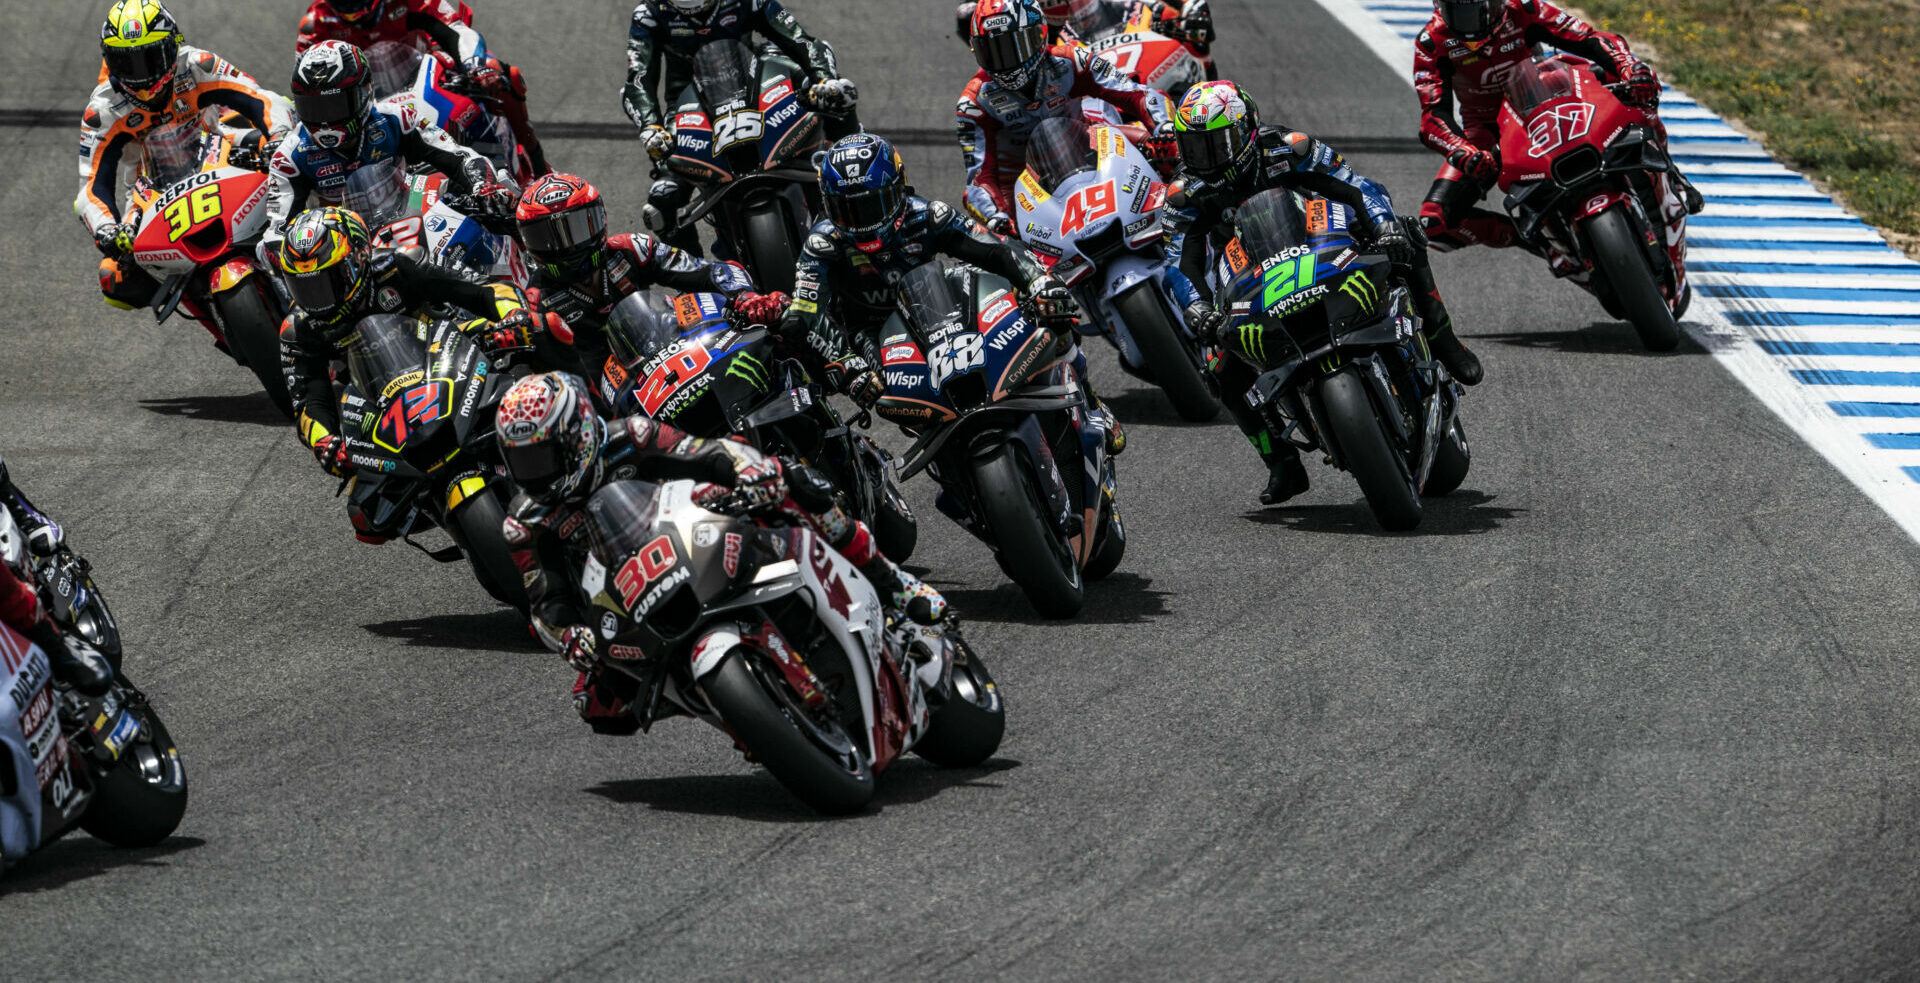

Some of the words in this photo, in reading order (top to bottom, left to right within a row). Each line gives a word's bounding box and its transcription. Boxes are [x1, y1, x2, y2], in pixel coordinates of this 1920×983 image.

[986, 17, 1008, 27] SHOEI
[1091, 32, 1141, 52] EPSOL
[1501, 42, 1514, 53] elf
[716, 101, 746, 115] aprilia
[766, 99, 800, 128] Wispr
[677, 135, 709, 150] Wispr
[712, 109, 765, 157] 25
[1528, 102, 1596, 158] 37
[316, 164, 343, 177] GIVI
[837, 173, 872, 187] SHARK
[1122, 165, 1141, 194] Unibat
[155, 171, 220, 212] REPSOL
[540, 190, 570, 204] HJC
[164, 184, 223, 243] 36
[1061, 180, 1118, 238] 49
[1332, 203, 1346, 229] YAMAHA
[1026, 223, 1052, 240] Unibat
[1127, 218, 1147, 233] BOLD
[434, 227, 456, 254] SENA
[136, 251, 183, 262] HONDA
[1261, 245, 1310, 272] ENEOS
[1262, 252, 1319, 312] 21
[1268, 284, 1329, 317] MONSTER
[928, 322, 963, 343] aprilia
[989, 317, 1027, 350] Wispr
[643, 339, 690, 375] ENEOS
[928, 333, 986, 394] 88
[1009, 337, 1047, 383] CryptoDATA
[386, 374, 420, 396] BARDAHL
[461, 361, 488, 417] mooneygo
[634, 338, 712, 418] 20
[885, 372, 924, 389] Wispr
[660, 372, 715, 420] MONSTER
[381, 382, 440, 447] 72
[508, 423, 535, 436] Arai
[352, 454, 396, 472] mooneygo
[724, 533, 742, 578] GIVI
[614, 535, 677, 612] 30
[634, 566, 690, 623] CUSTOM
[609, 644, 645, 660] GIVI
[10, 653, 46, 710] DUCATI
